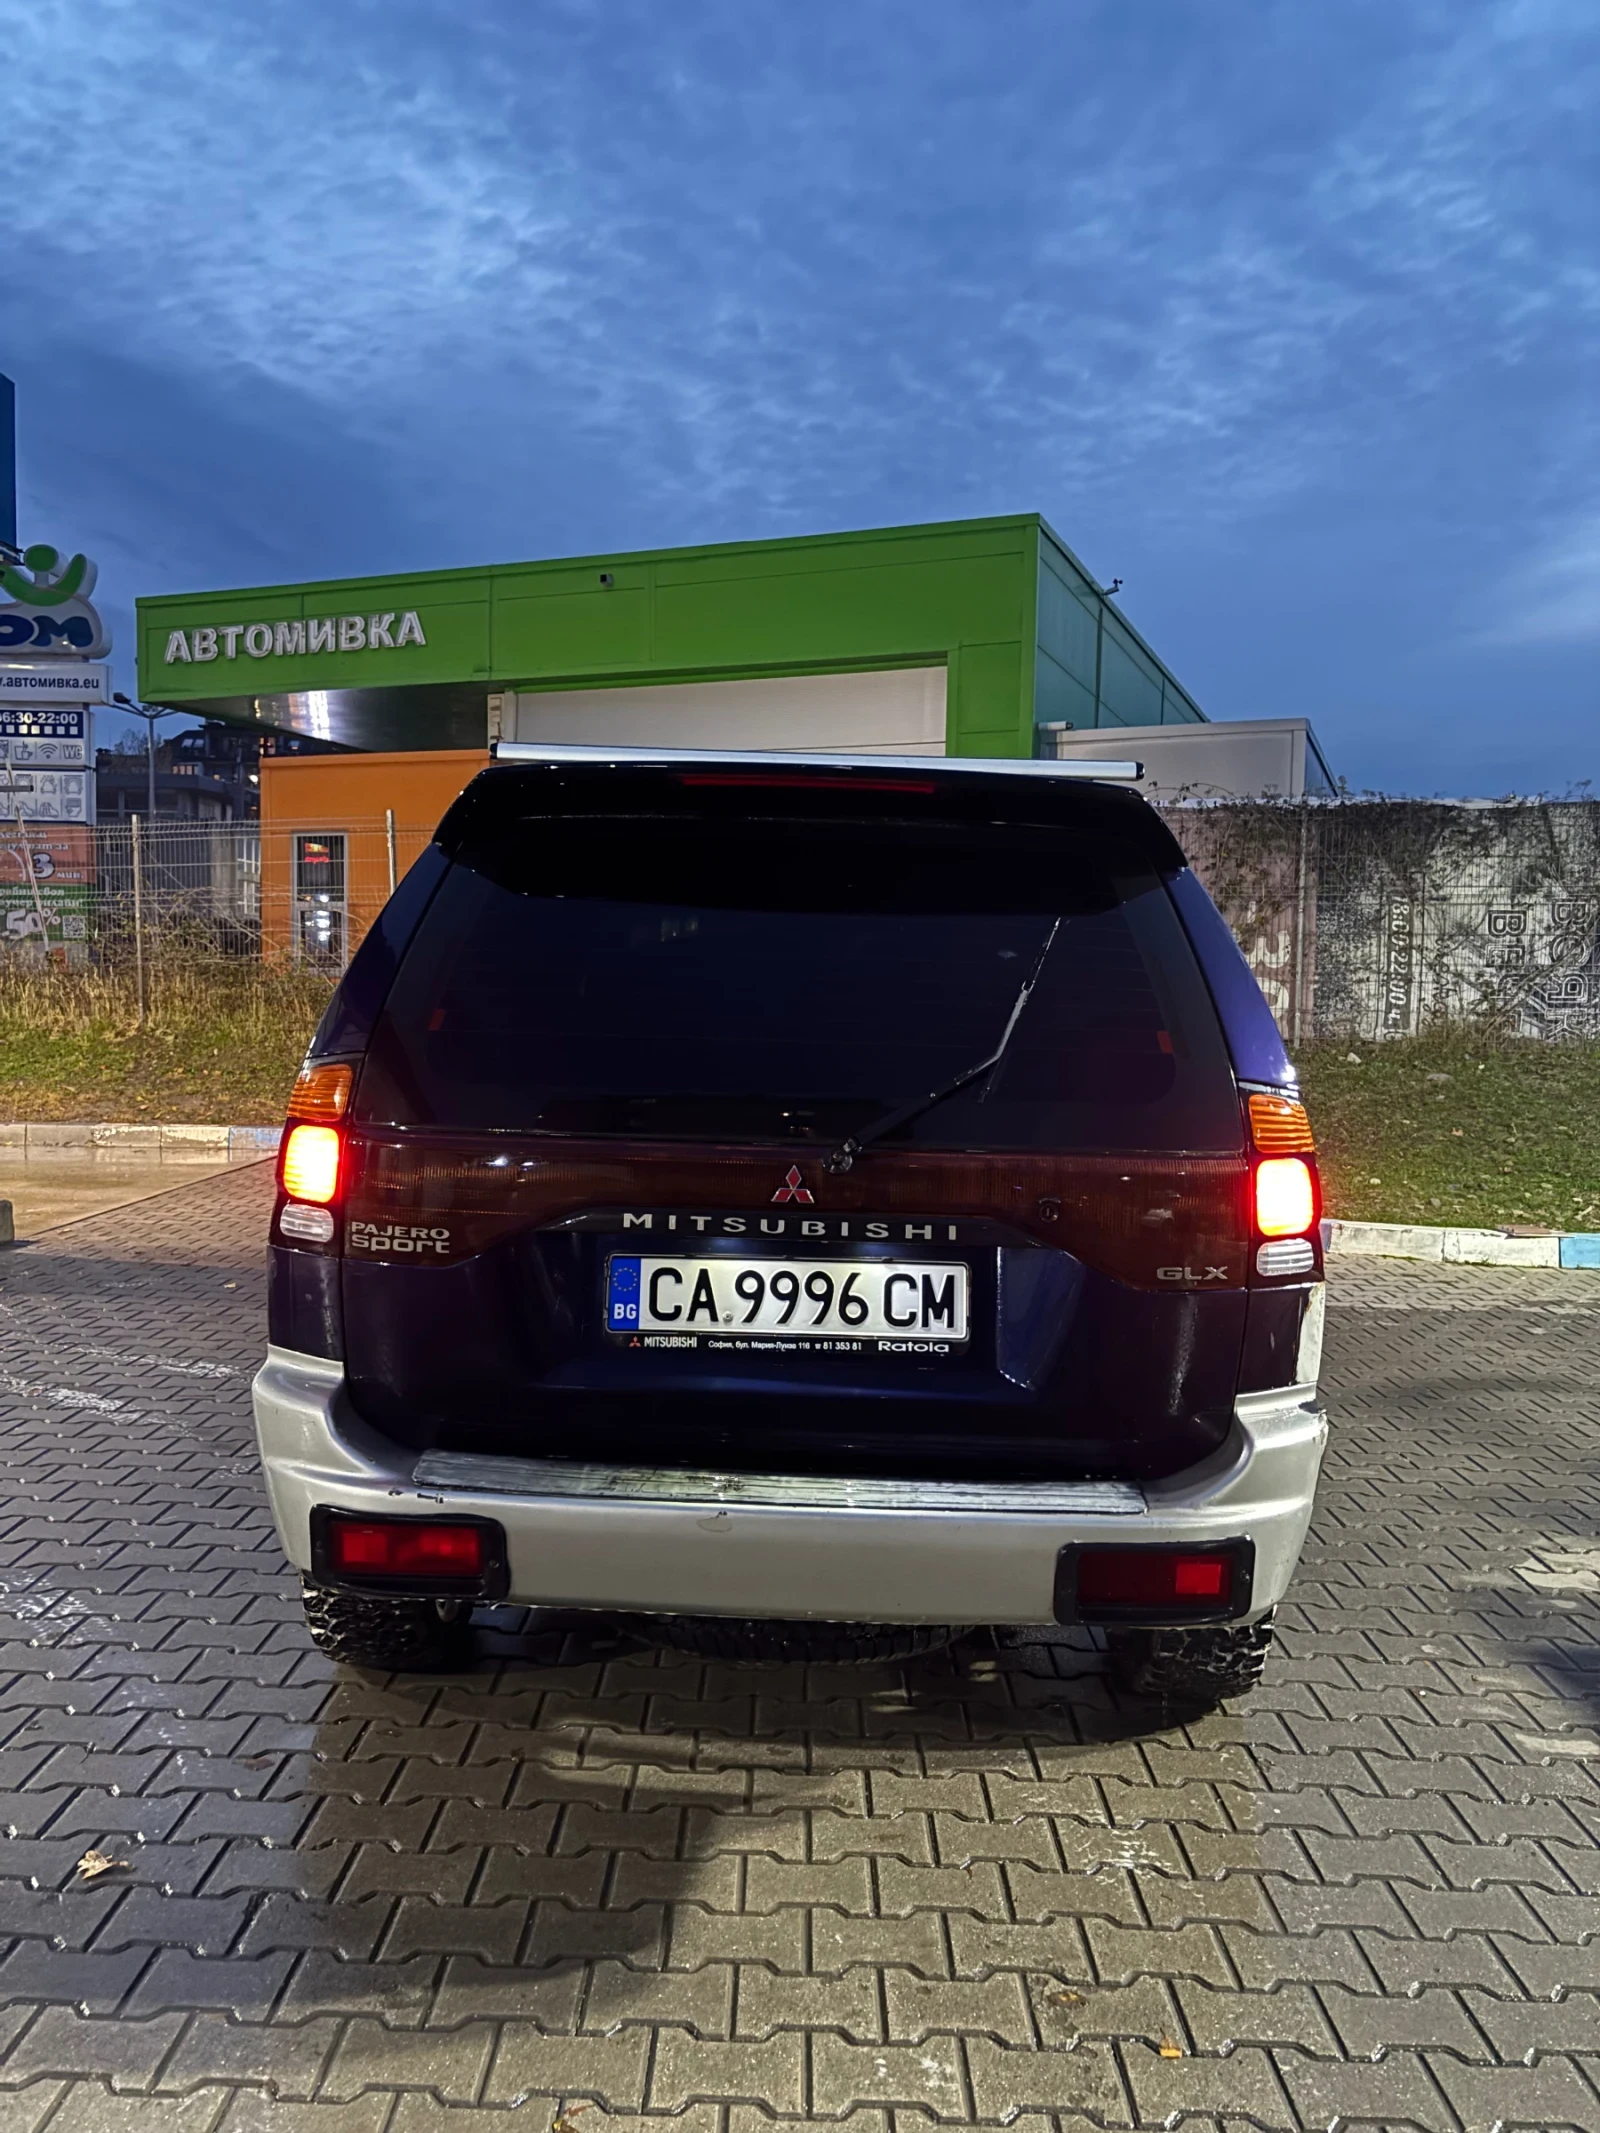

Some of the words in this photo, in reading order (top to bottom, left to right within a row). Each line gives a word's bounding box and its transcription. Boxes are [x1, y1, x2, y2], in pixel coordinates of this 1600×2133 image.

[164, 611, 427, 664] АВТОМИВКА
[0, 676, 99, 689] .автомивка.eu
[0, 712, 78, 724] 6:30-22:00
[63, 744, 83, 760] WC
[32, 852, 56, 879] 3
[351, 1221, 450, 1240] PAJERO
[623, 1213, 957, 1241] MITSUBISHI
[1156, 1266, 1229, 1281] GLX
[648, 1267, 719, 1323] CA
[734, 1269, 869, 1326] 9996
[883, 1273, 955, 1330] CM
[613, 1303, 637, 1320] BG
[643, 1336, 698, 1348] MITSUBISHI
[708, 1340, 734, 1349] София,
[735, 1340, 750, 1349] бул.
[823, 1342, 833, 1350] 81
[835, 1342, 850, 1351] 353
[852, 1342, 862, 1351] 81
[878, 1340, 950, 1352] Ratola
